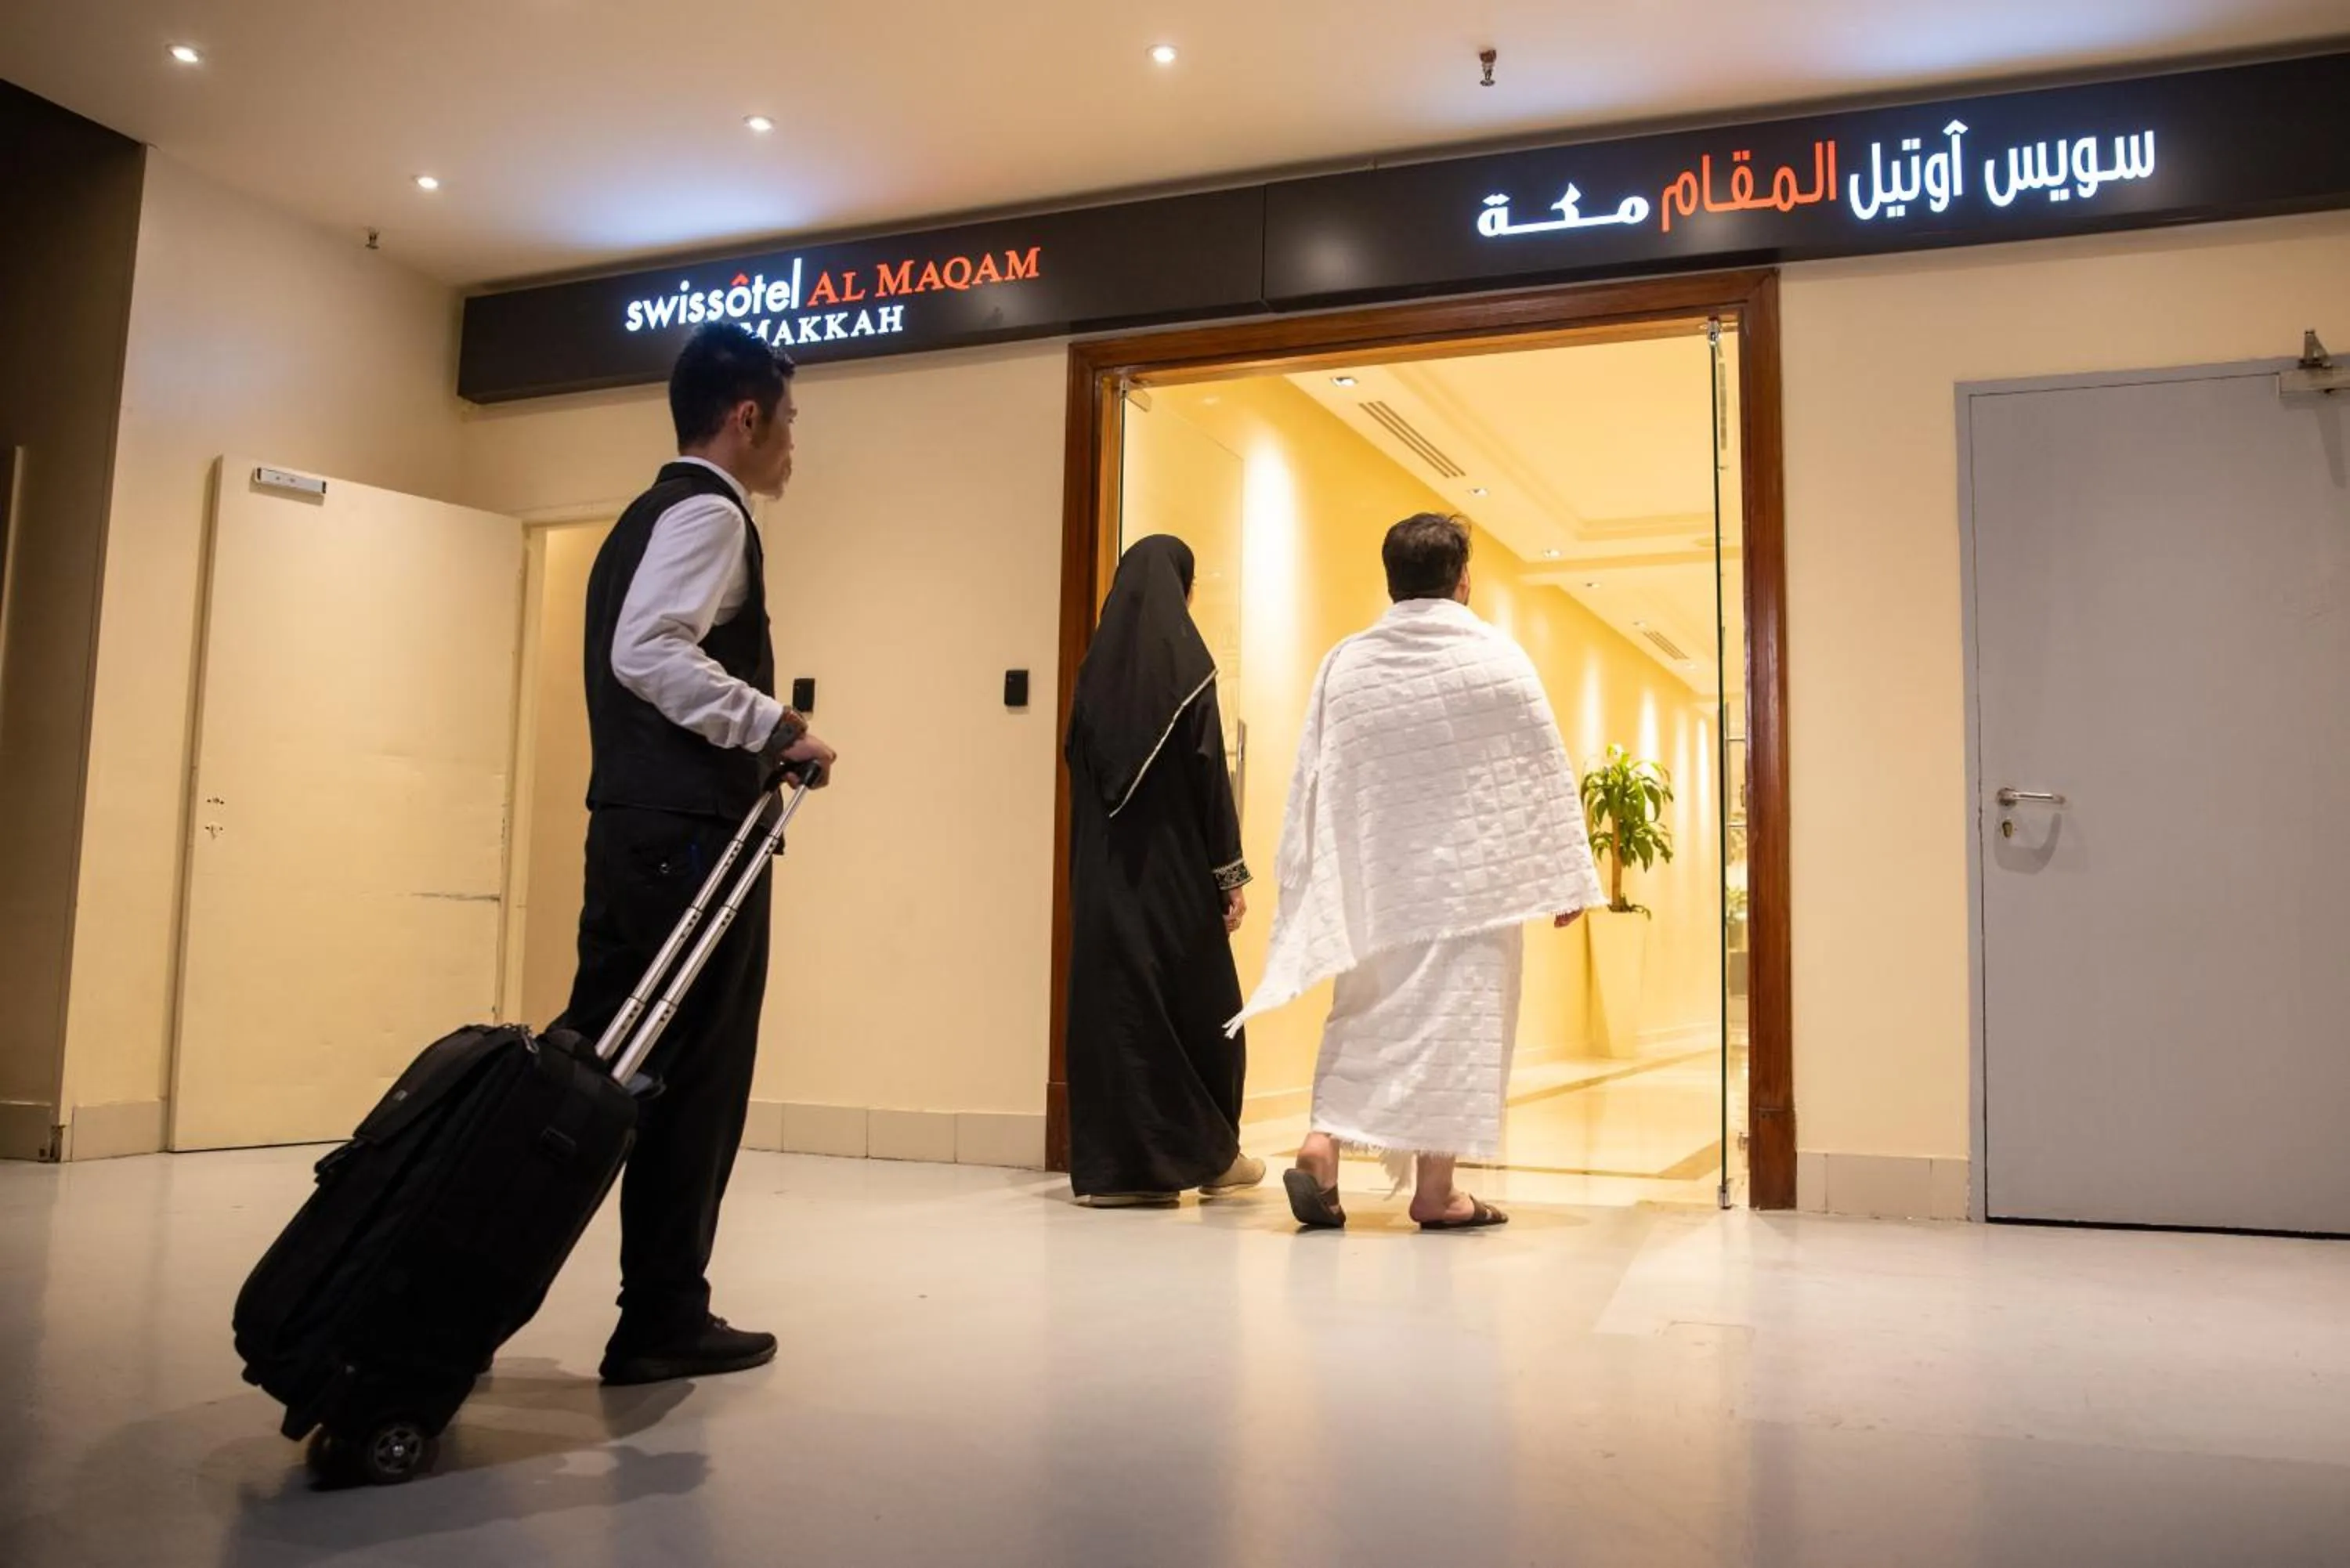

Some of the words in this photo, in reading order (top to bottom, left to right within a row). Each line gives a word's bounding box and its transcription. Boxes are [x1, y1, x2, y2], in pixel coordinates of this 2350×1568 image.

[1477, 182, 1650, 237] مكة
[1661, 141, 1837, 231] المقام
[1984, 130, 2155, 208] سويس
[625, 257, 802, 331] swissôtel
[808, 272, 865, 305] AL
[876, 247, 1040, 297] MAQAM
